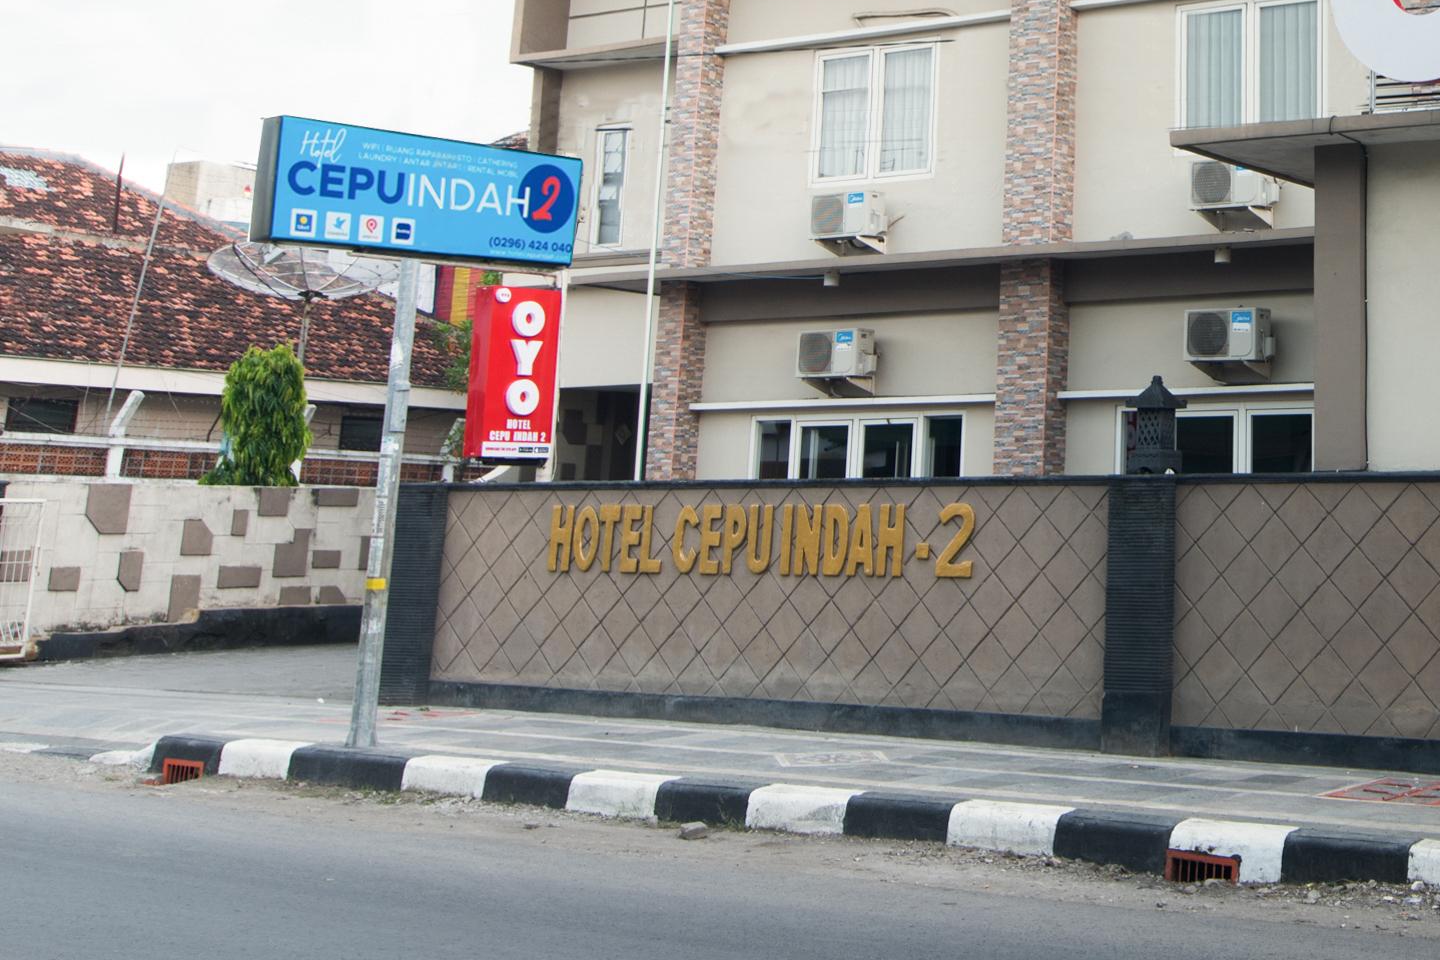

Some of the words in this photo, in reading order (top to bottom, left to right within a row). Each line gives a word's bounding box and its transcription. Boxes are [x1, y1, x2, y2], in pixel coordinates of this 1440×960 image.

[300, 128, 347, 168] Hotel
[358, 152, 397, 161] LAUNDRY
[531, 176, 561, 221] 2
[489, 236, 525, 250] (0296)
[528, 239, 549, 251] 424
[551, 242, 573, 254] 040
[505, 300, 546, 416] OYO
[489, 430, 511, 441] CEPU
[540, 431, 547, 443] 2
[506, 418, 531, 430] HOTEL
[547, 504, 662, 573] HOTEL
[671, 504, 774, 575] CEPU
